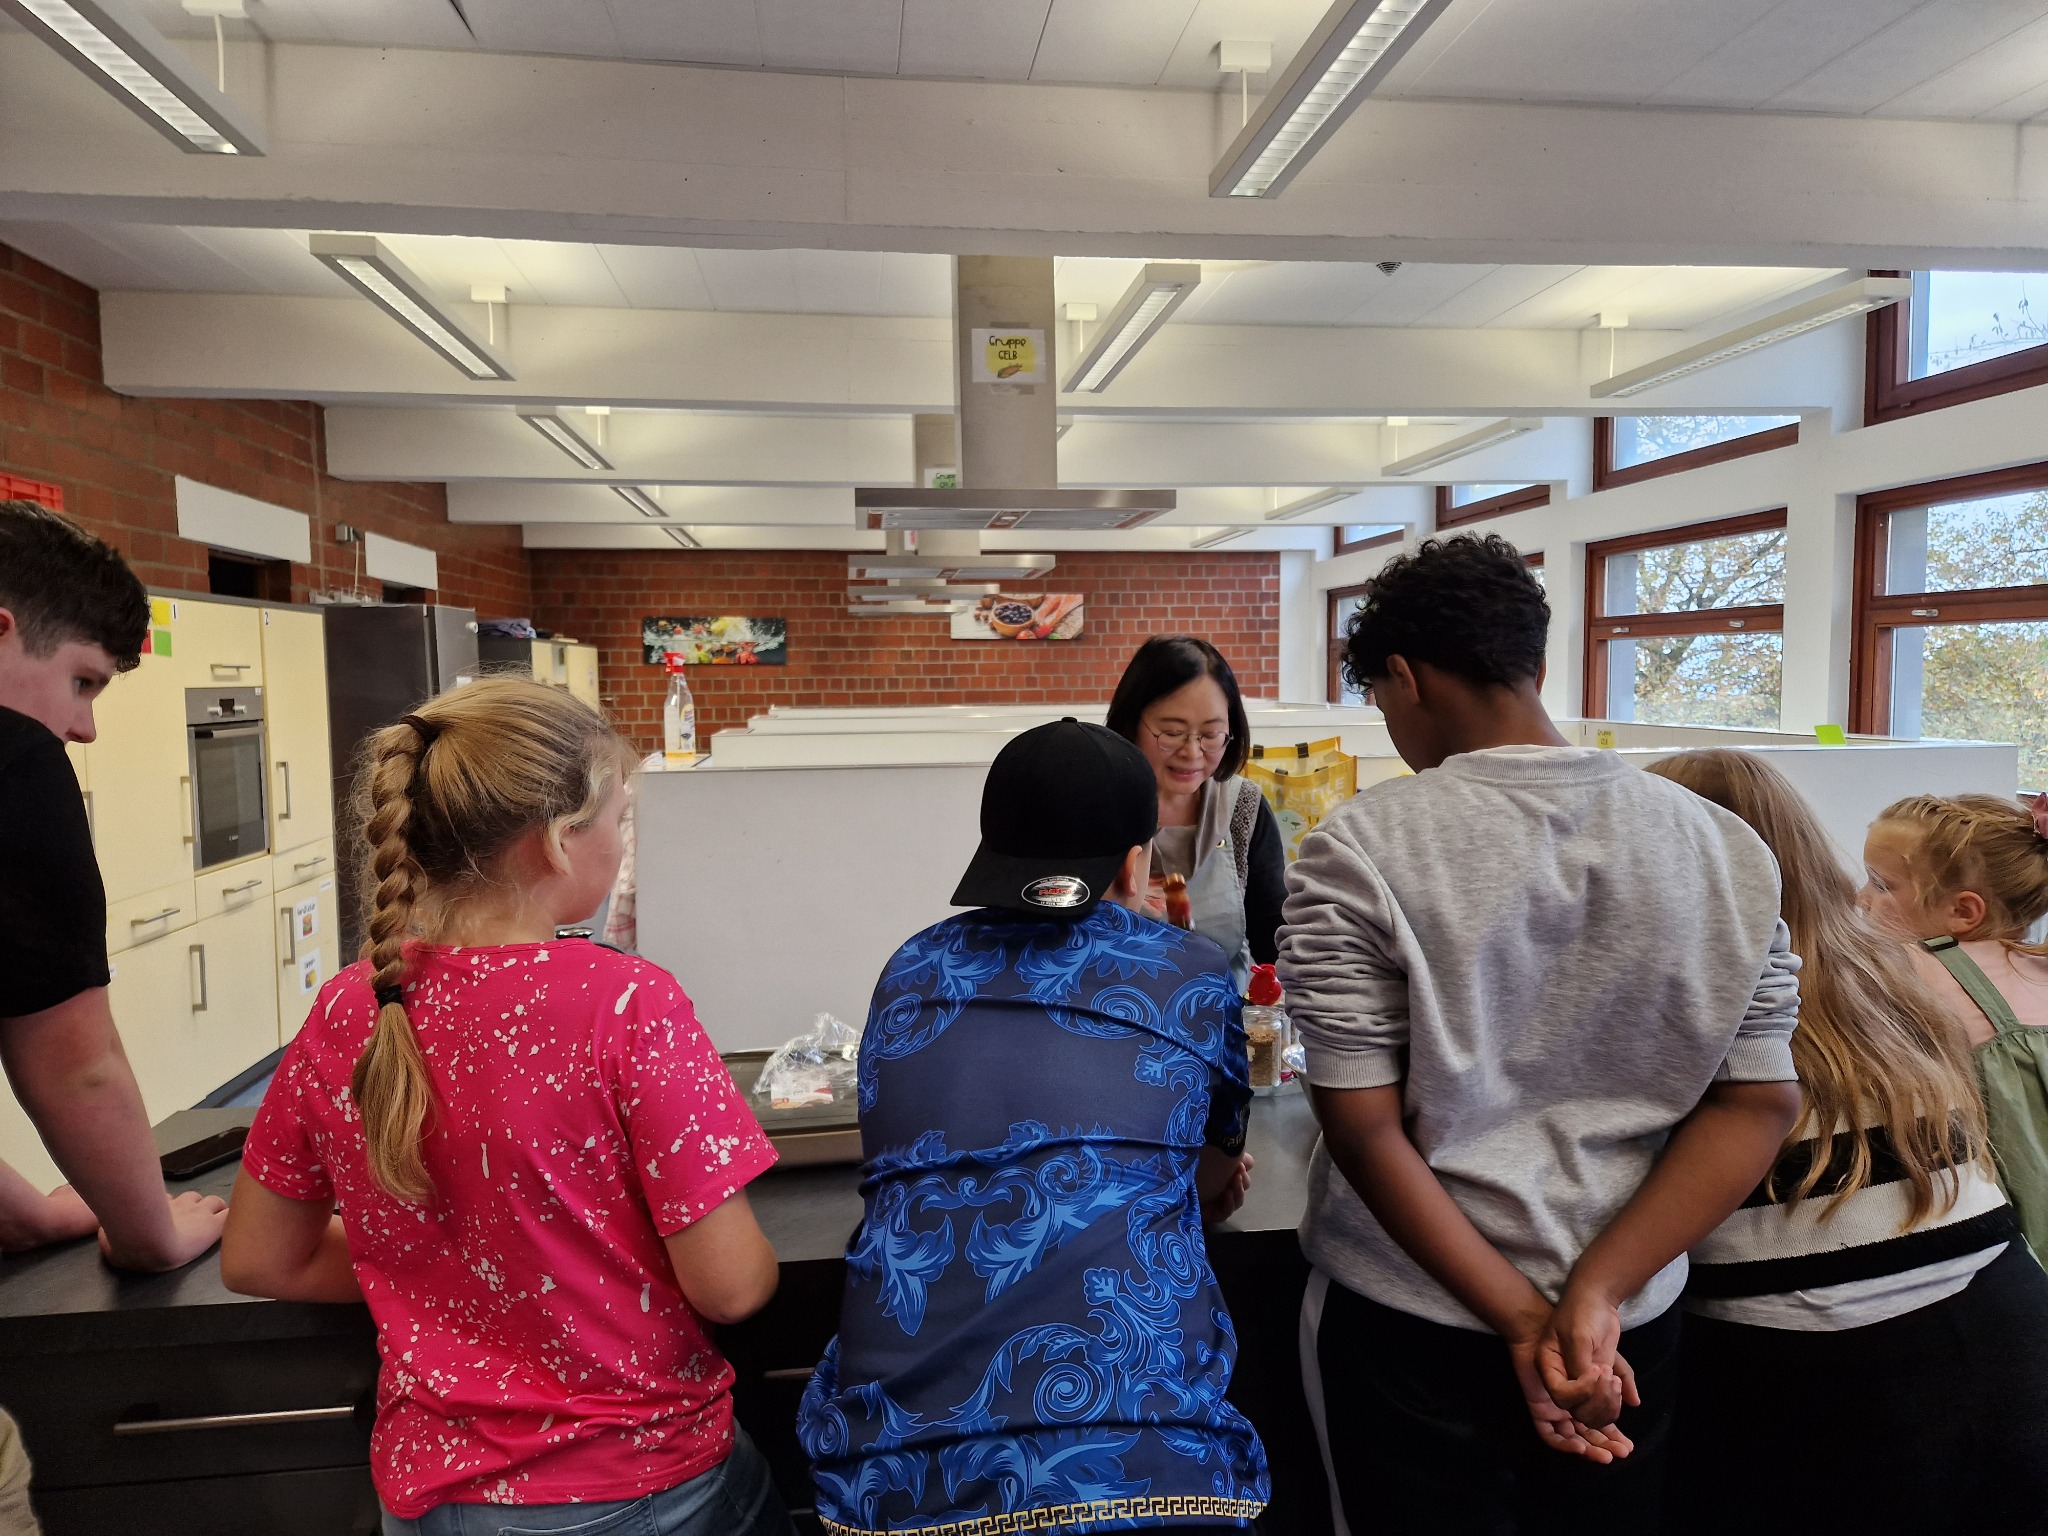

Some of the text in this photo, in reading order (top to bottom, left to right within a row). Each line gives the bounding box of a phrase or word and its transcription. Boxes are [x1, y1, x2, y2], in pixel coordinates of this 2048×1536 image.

[988, 335, 1027, 350] Gruppe
[998, 350, 1018, 361] GELB
[265, 611, 270, 625] 2
[1289, 776, 1345, 803] LITTLE
